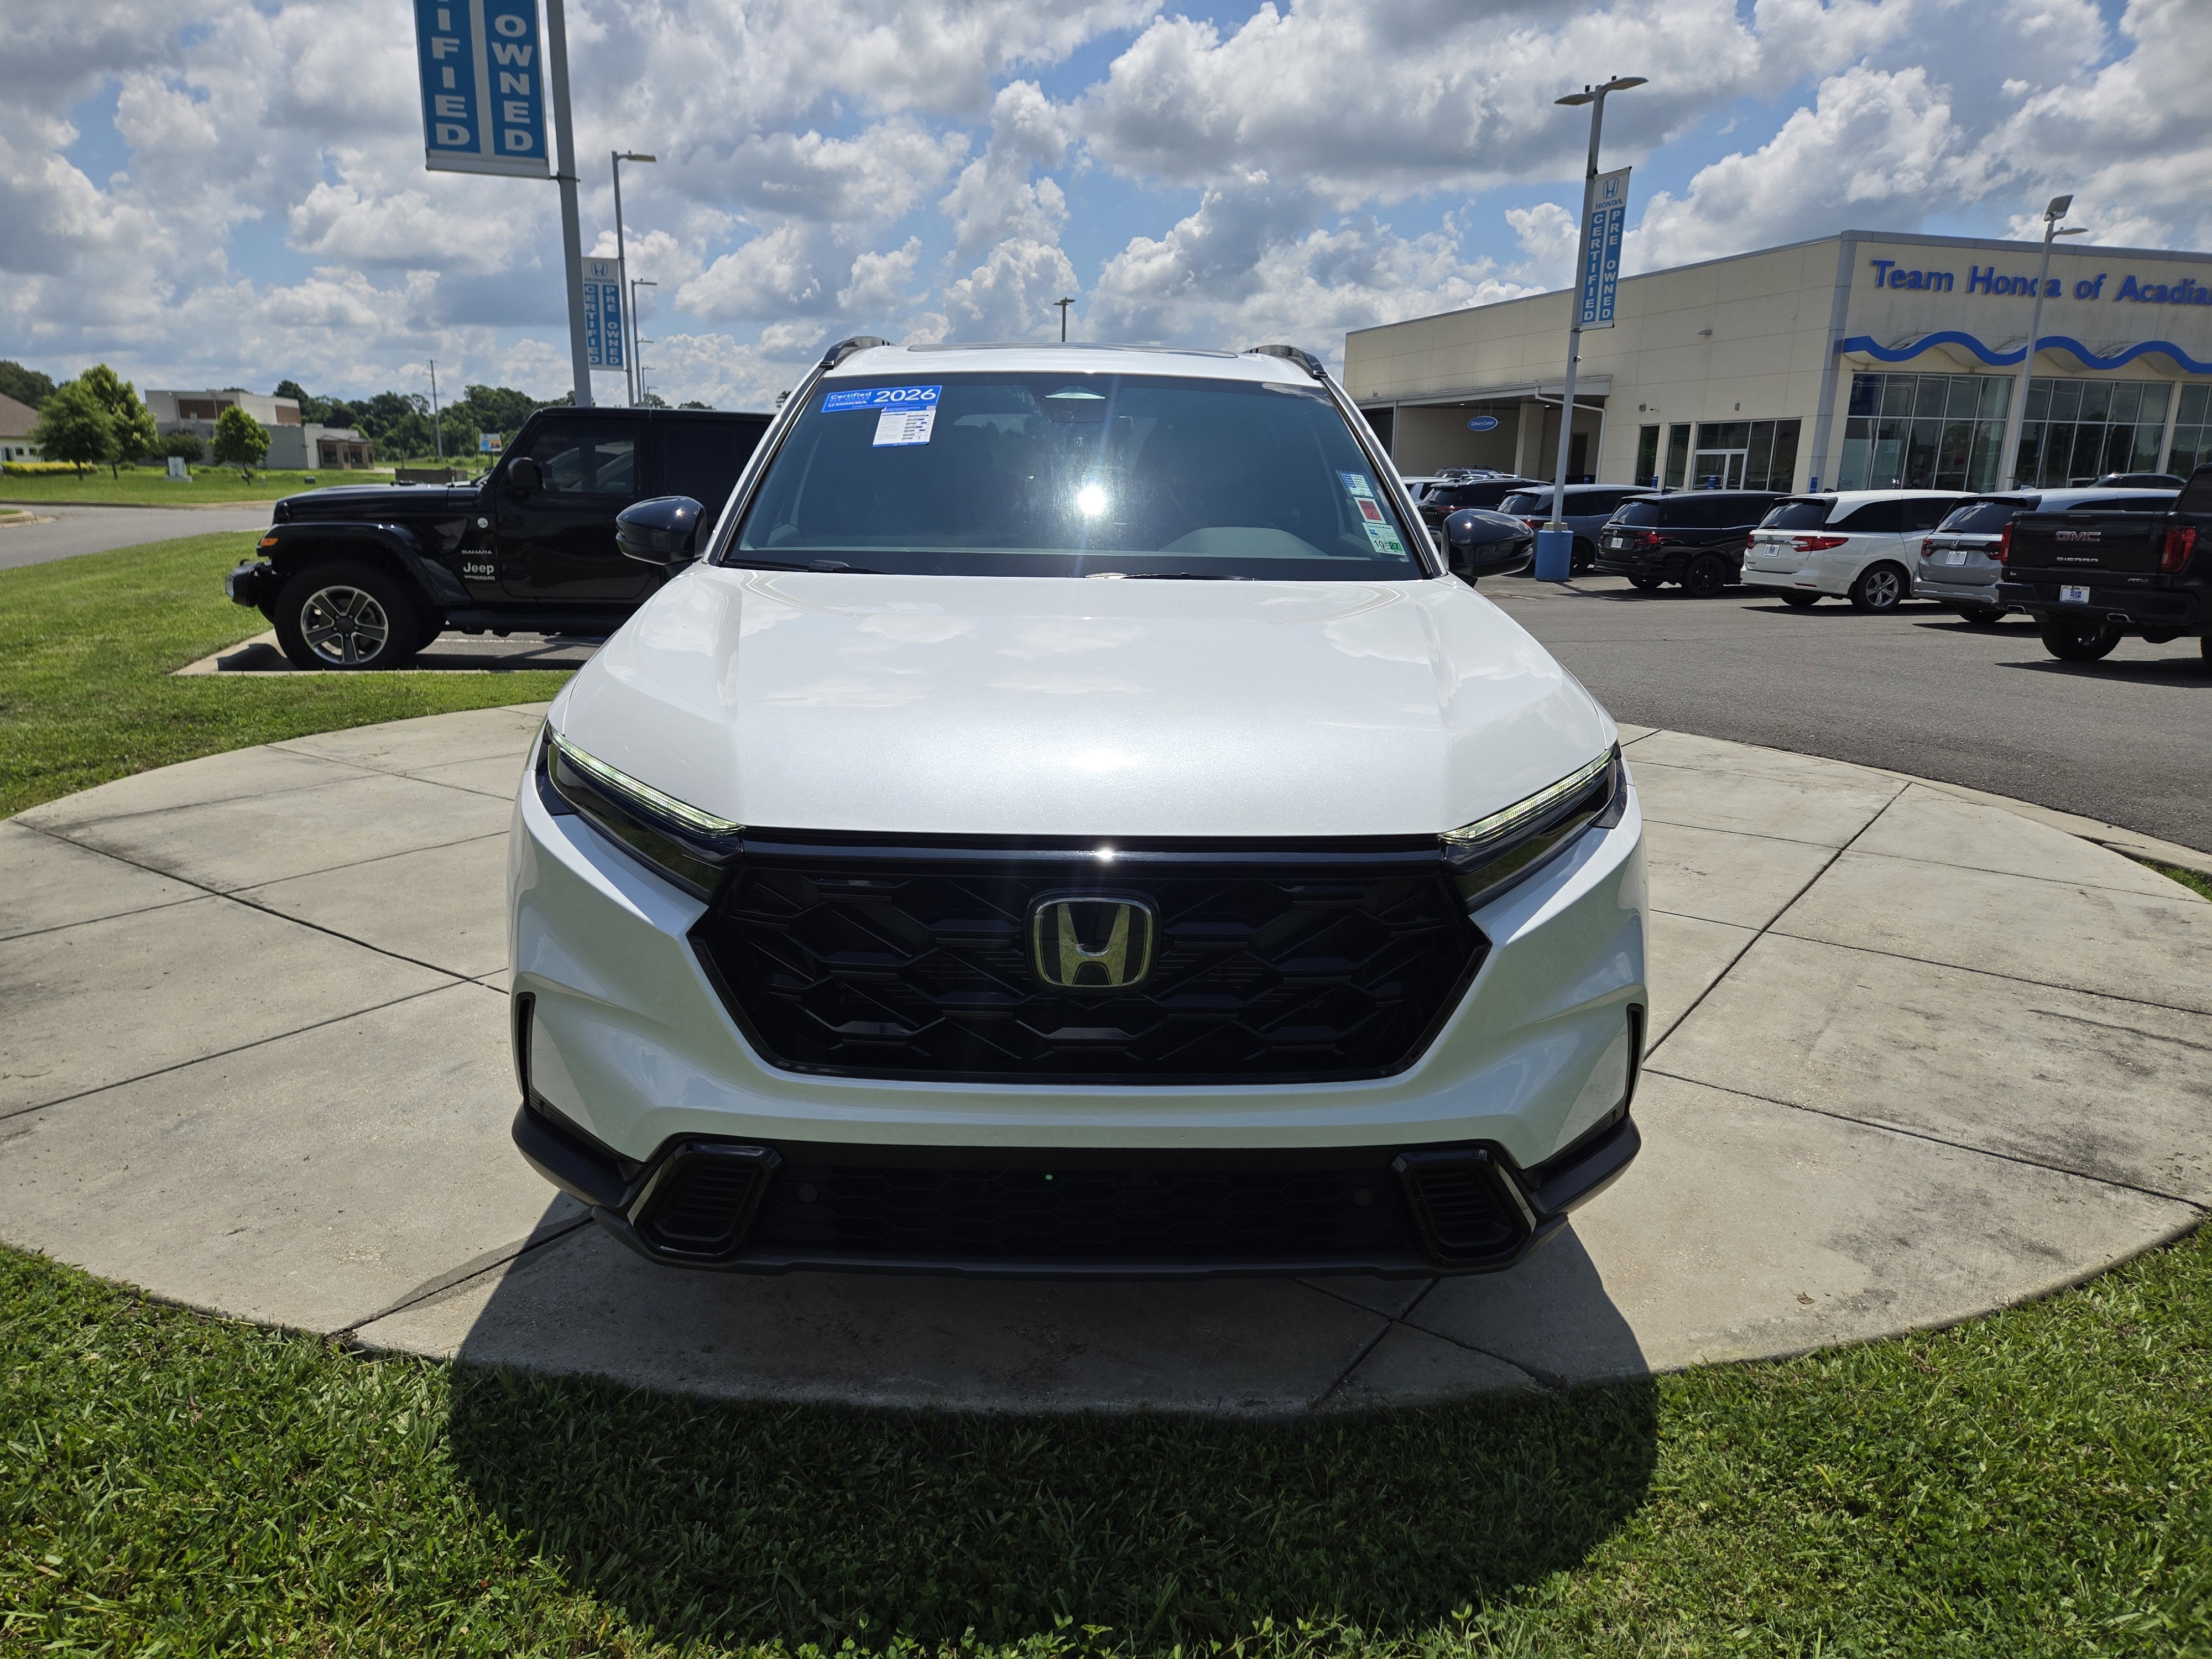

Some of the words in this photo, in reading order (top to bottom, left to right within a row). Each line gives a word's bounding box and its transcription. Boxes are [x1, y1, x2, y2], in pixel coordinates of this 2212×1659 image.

[432, 0, 470, 146] IFIED
[491, 15, 533, 152] OWNED
[1595, 199, 1623, 210] HONDA
[1609, 210, 1621, 246] PRE
[1584, 213, 1604, 321] CERTIFIED
[1870, 259, 1954, 293] Team
[2075, 274, 2107, 300] of
[2113, 275, 2212, 306] Acadia
[606, 286, 616, 312] PRE
[1601, 259, 1616, 319] OWNED
[585, 285, 599, 363] CERTIFIED
[607, 321, 619, 364] OWNED
[873, 389, 936, 403] 2026
[2056, 531, 2101, 542] GMC
[463, 562, 494, 575] Jeep
